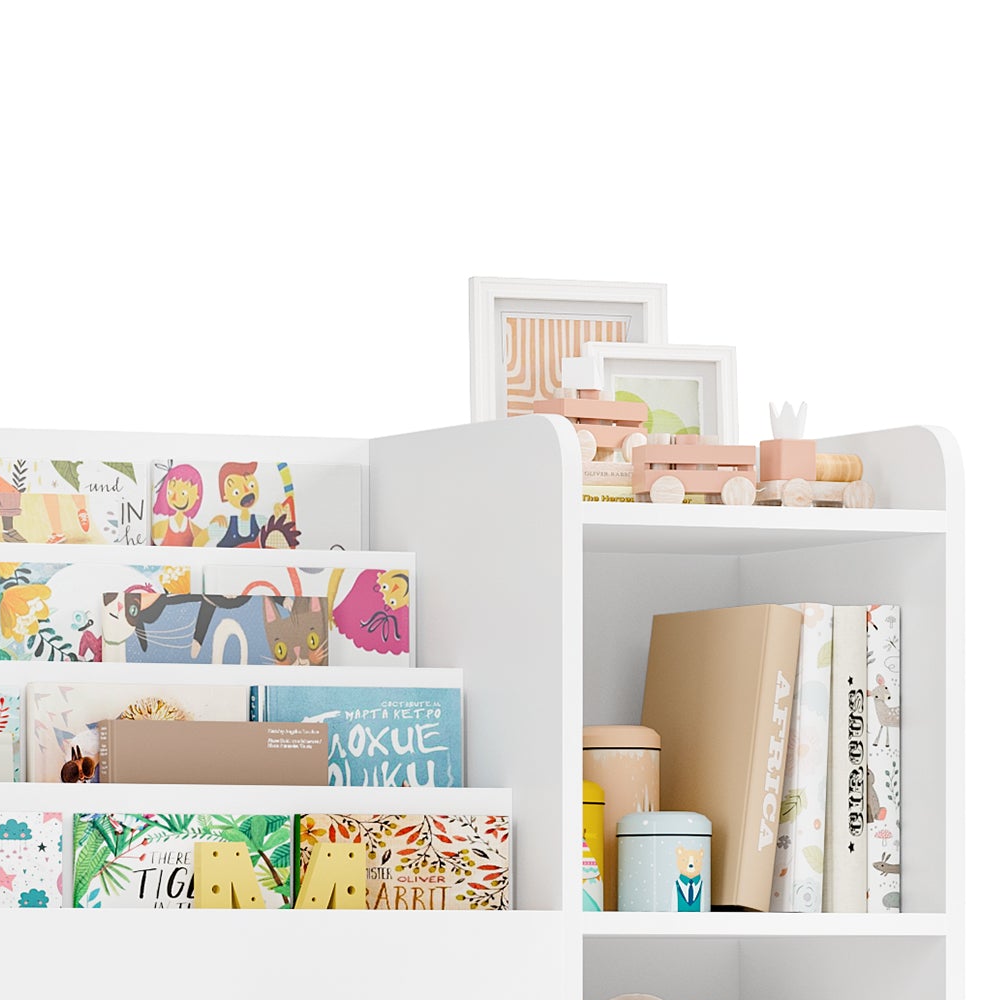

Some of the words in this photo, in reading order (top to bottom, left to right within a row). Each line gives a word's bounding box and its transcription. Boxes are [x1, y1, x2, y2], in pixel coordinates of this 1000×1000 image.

[84, 476, 124, 493] und
[582, 494, 600, 503] The
[345, 708, 388, 721] МАРТА
[393, 708, 441, 719] КЕТРО
[758, 670, 791, 851] AFRICA
[848, 688, 864, 837] CIRCUS
[151, 851, 191, 865] THERE
[397, 875, 446, 884] OLIVER
